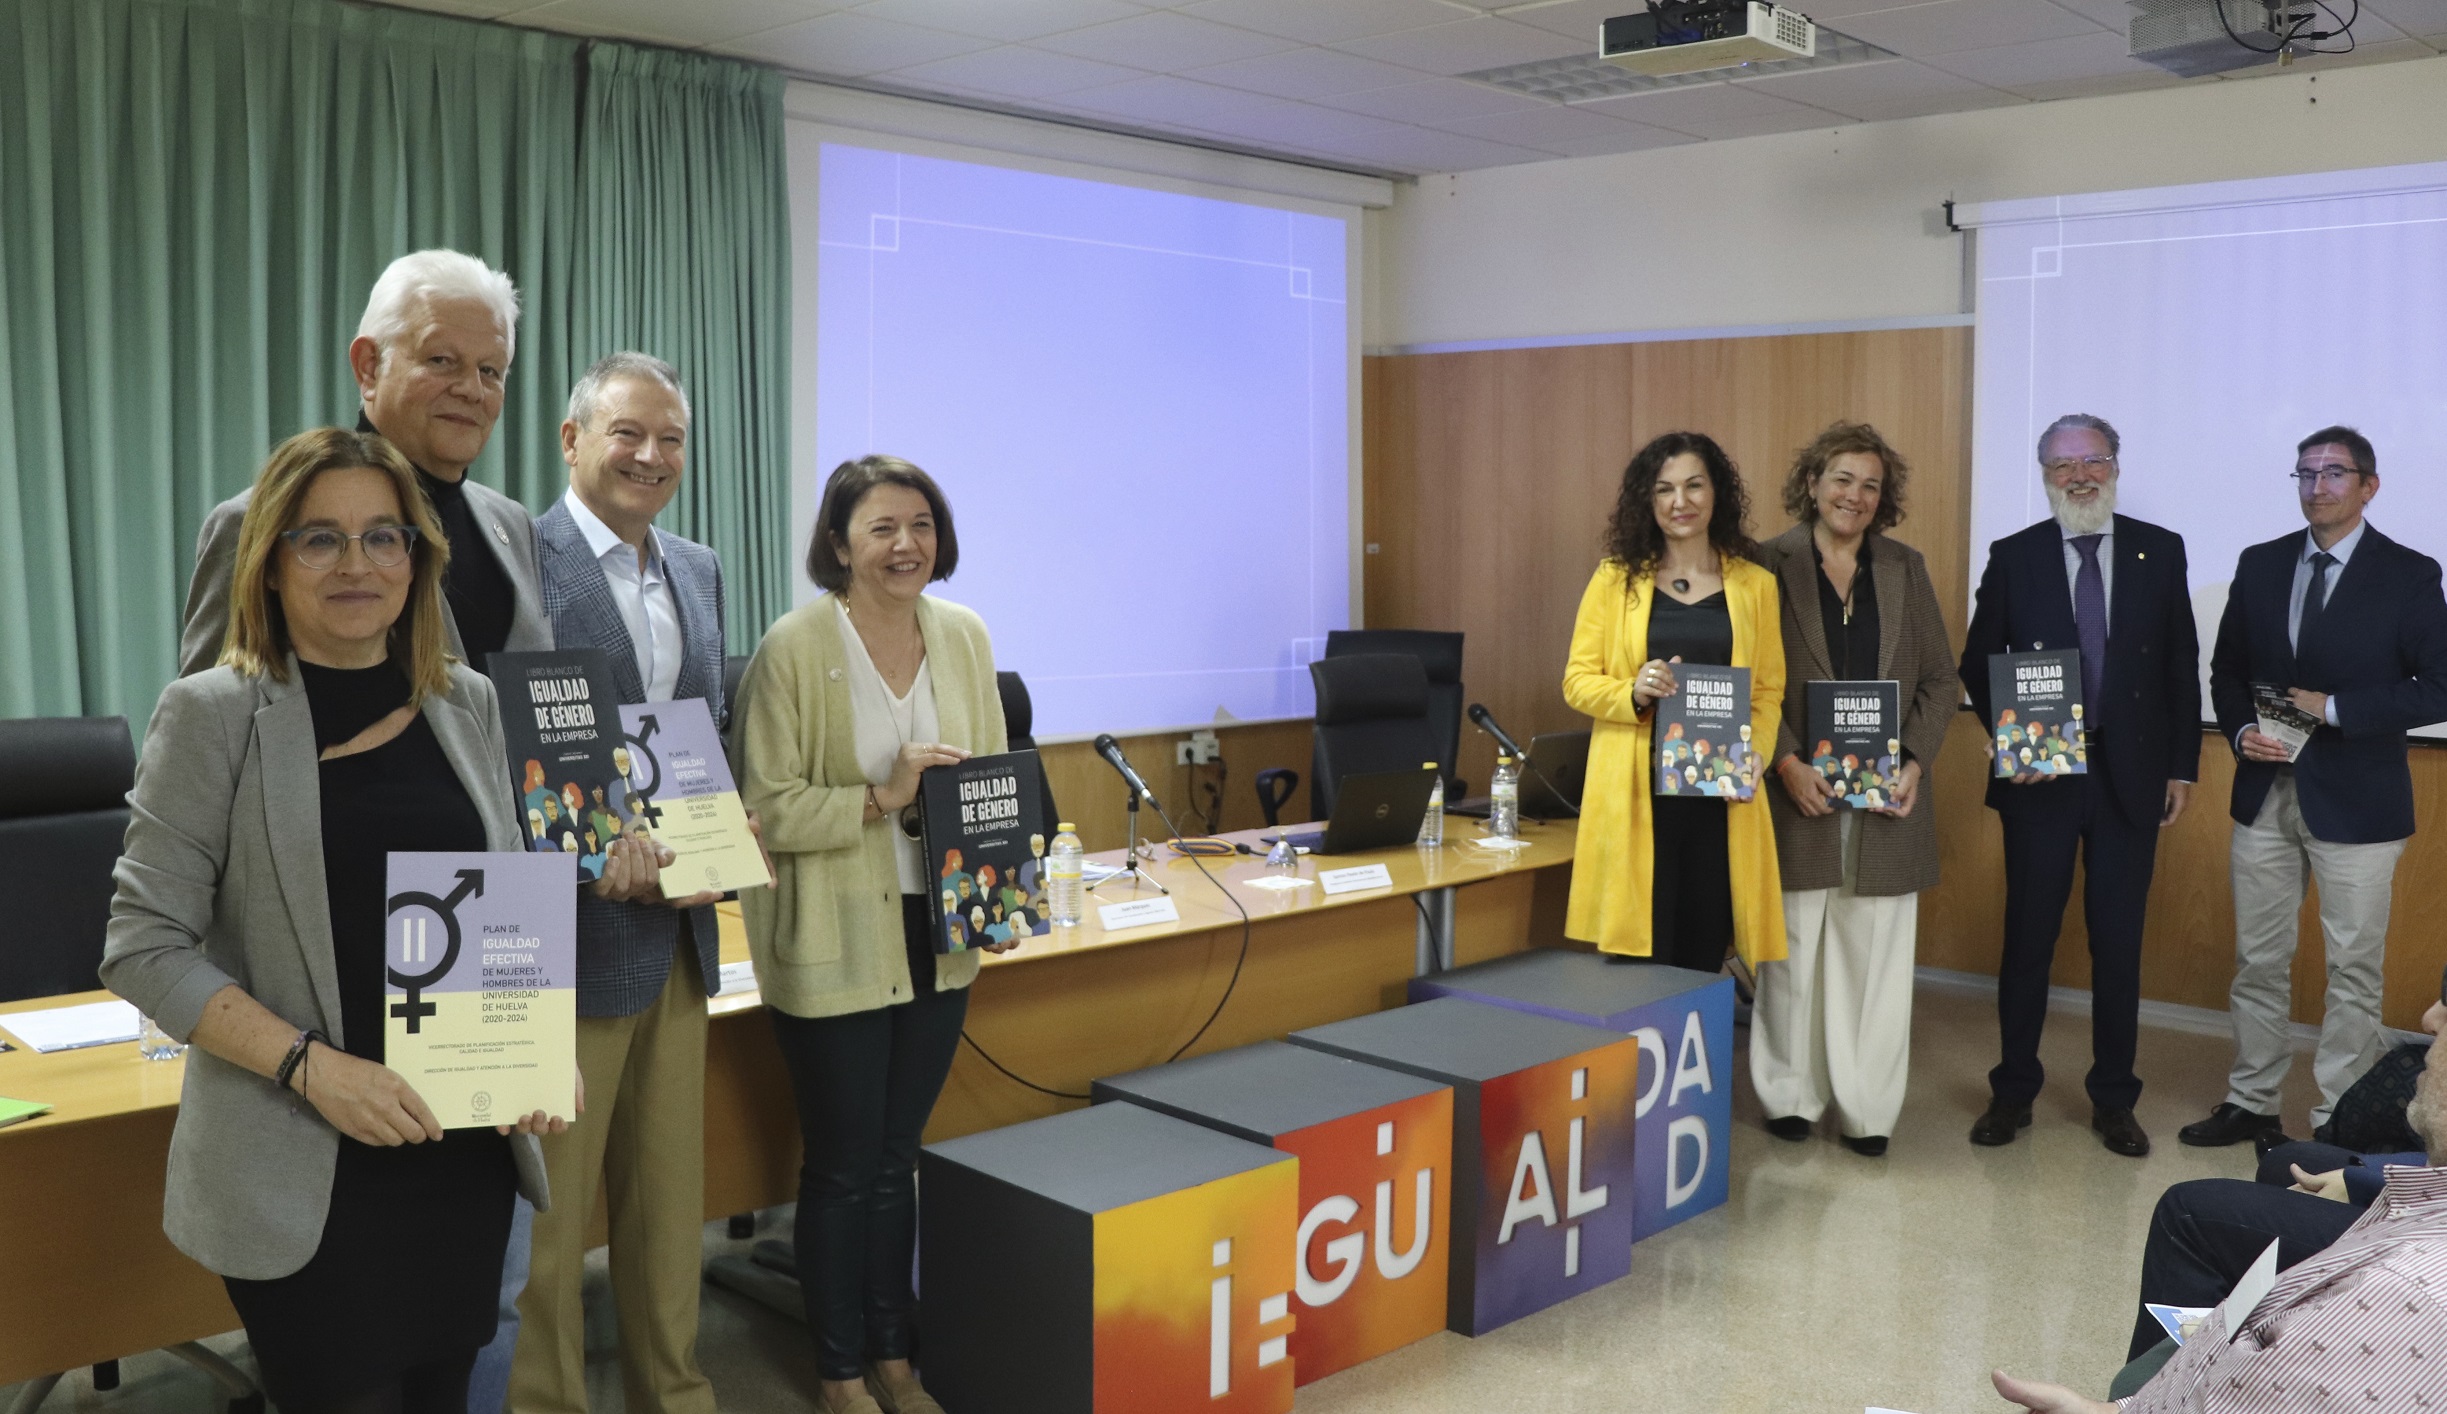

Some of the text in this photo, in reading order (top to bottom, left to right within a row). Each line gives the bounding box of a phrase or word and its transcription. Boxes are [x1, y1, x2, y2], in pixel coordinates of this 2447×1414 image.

[574, 666, 584, 674] DE
[2016, 665, 2062, 680] IGUALDAD
[529, 678, 590, 703] IGUALDAD
[1686, 680, 1733, 696] IGUALDAD
[2017, 679, 2063, 694] DE GÉNERO
[1686, 693, 1733, 710] DE GÉNERO
[1834, 698, 1880, 711] IGUALDAD
[535, 702, 596, 730] DE GÉNERO
[1704, 710, 1732, 718] EMPRESA
[1834, 710, 1880, 725] DE GÉNERO
[540, 729, 598, 744] EN LA EMPRESA
[672, 758, 705, 768] IGUALDAD
[676, 769, 707, 780] EFECTIVA
[979, 768, 1004, 778] BLANCO
[1006, 766, 1014, 774] DE
[960, 776, 1017, 801] IGUALDAD
[962, 798, 1019, 823] DE GÉNERO
[963, 819, 1019, 834] EN LA EMPRESA
[483, 925, 520, 934] PLAN DE
[483, 938, 540, 949] IGUALDAD
[482, 953, 535, 965] EFECTIVA
[482, 967, 543, 976] DE MUJERES Y
[482, 978, 551, 988] HOMBRES DE LA
[482, 990, 539, 1000] UNIVERSIDAD
[482, 1002, 528, 1012] DE HUELVA
[482, 1014, 528, 1023] (2020-2024)
